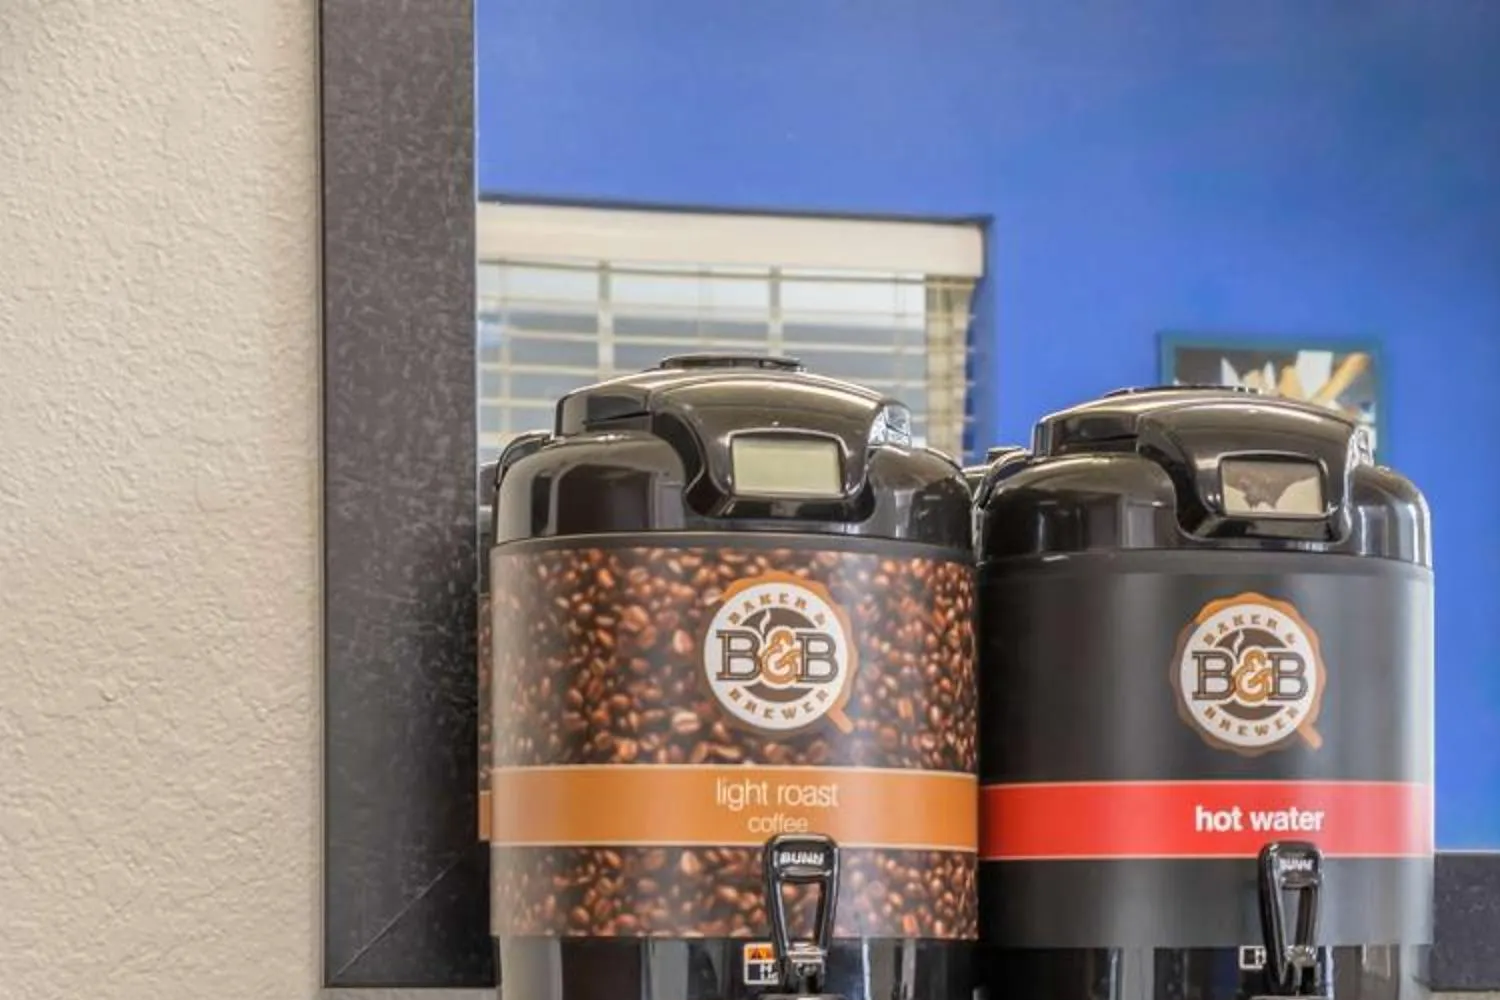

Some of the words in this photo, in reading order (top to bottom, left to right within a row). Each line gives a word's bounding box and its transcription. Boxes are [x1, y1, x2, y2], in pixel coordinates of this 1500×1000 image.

[716, 628, 838, 685] B&B
[1191, 649, 1308, 702] B&B
[728, 687, 829, 720] BREWER
[716, 777, 768, 809] light
[777, 782, 838, 807] roast
[748, 813, 808, 833] coffee
[1195, 805, 1242, 831] hot
[1250, 806, 1325, 831] water
